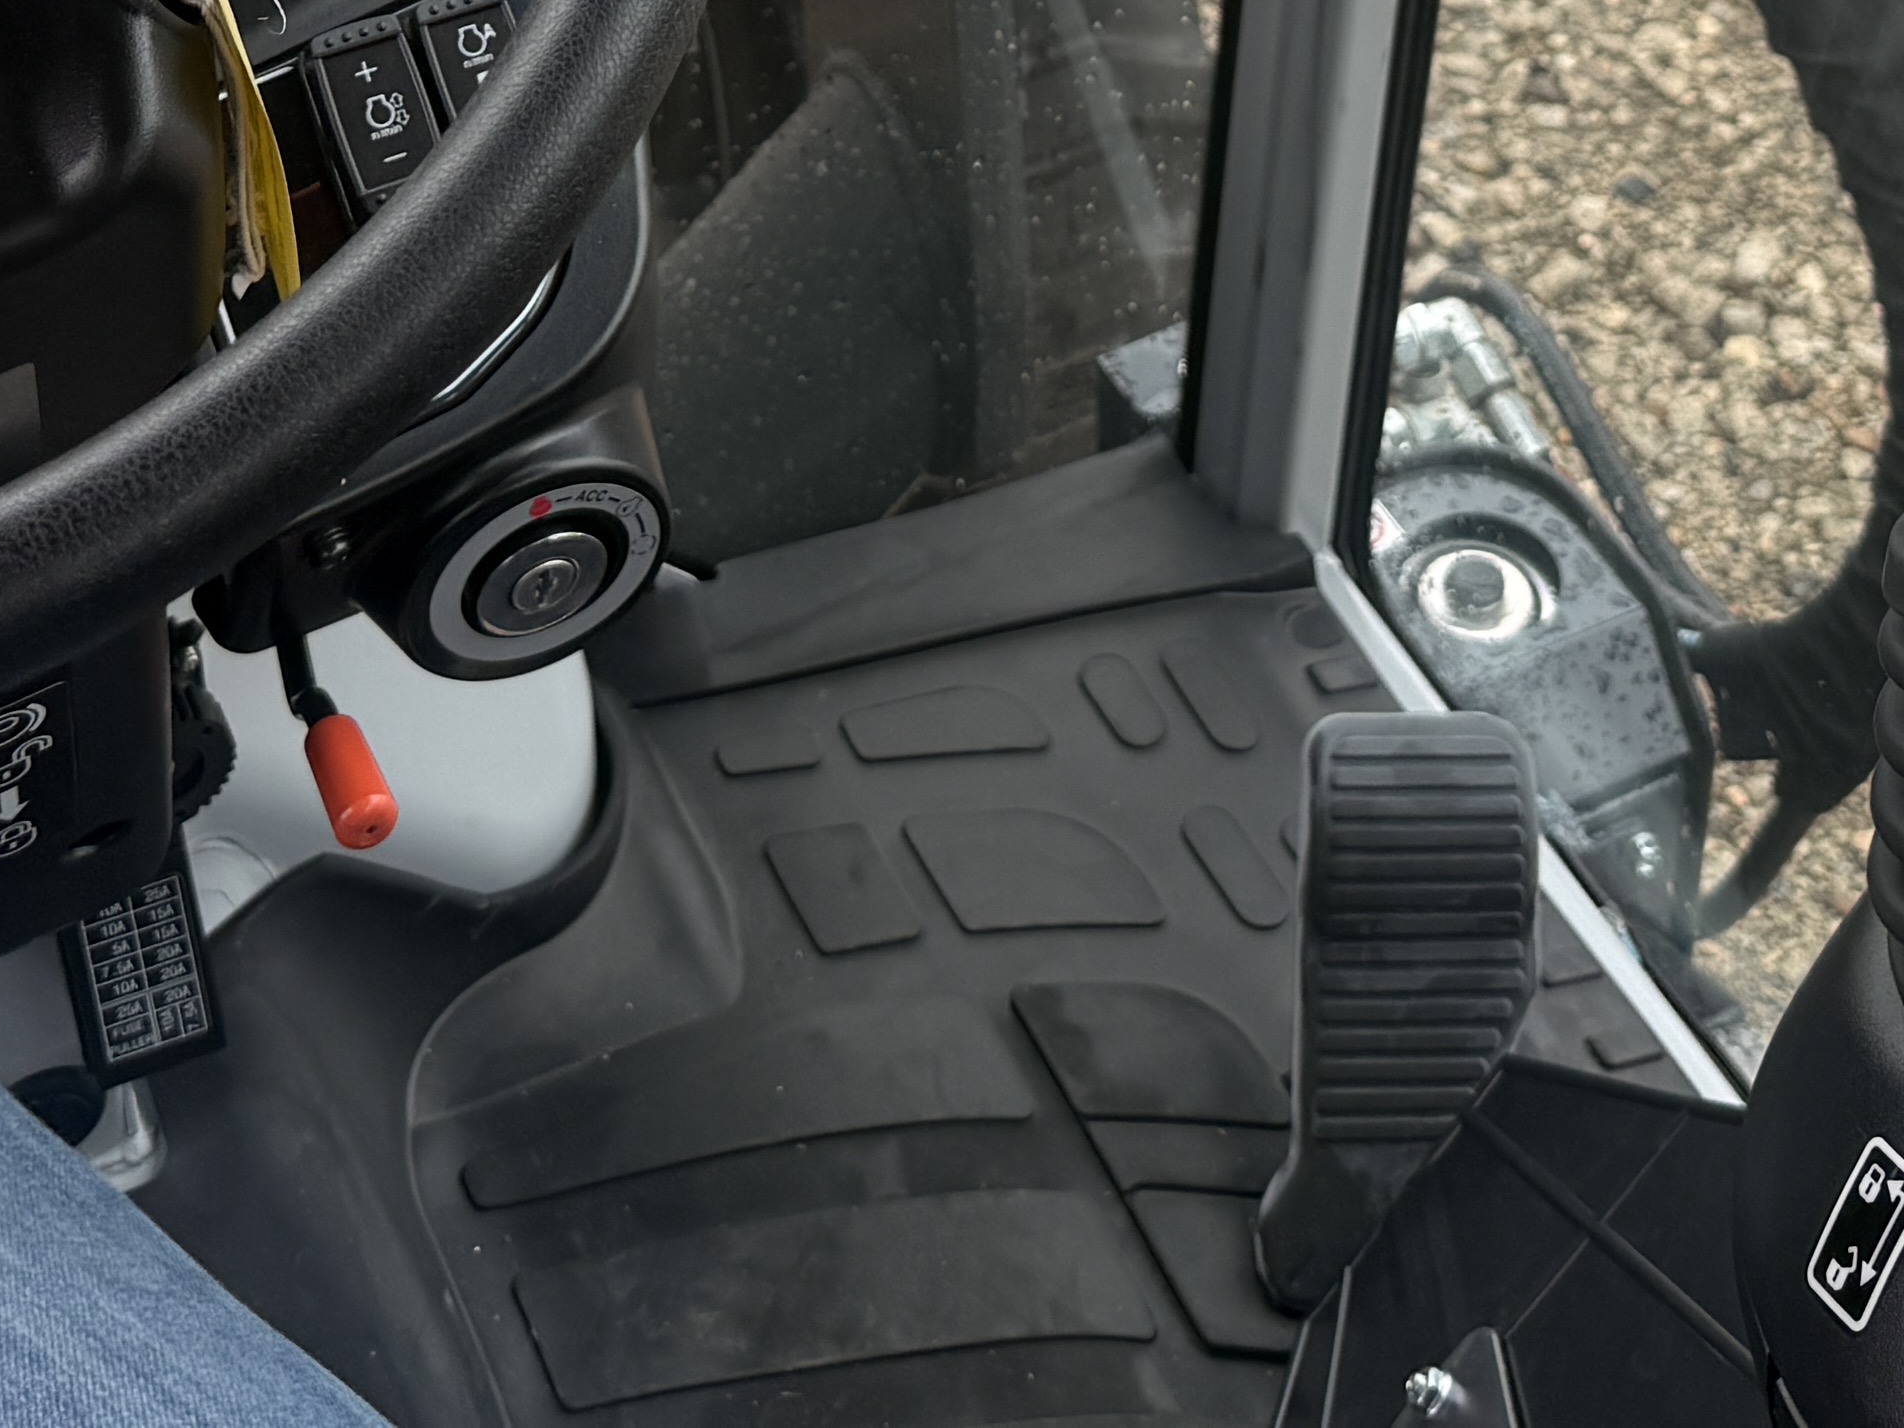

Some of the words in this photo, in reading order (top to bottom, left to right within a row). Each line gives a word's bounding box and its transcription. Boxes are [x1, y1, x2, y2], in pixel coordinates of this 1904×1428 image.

[574, 489, 608, 503] ACC
[100, 919, 127, 938] 10A
[156, 943, 184, 962] 20A
[159, 962, 188, 981] 20A
[112, 978, 140, 995] 10A
[163, 985, 192, 1004] 20A
